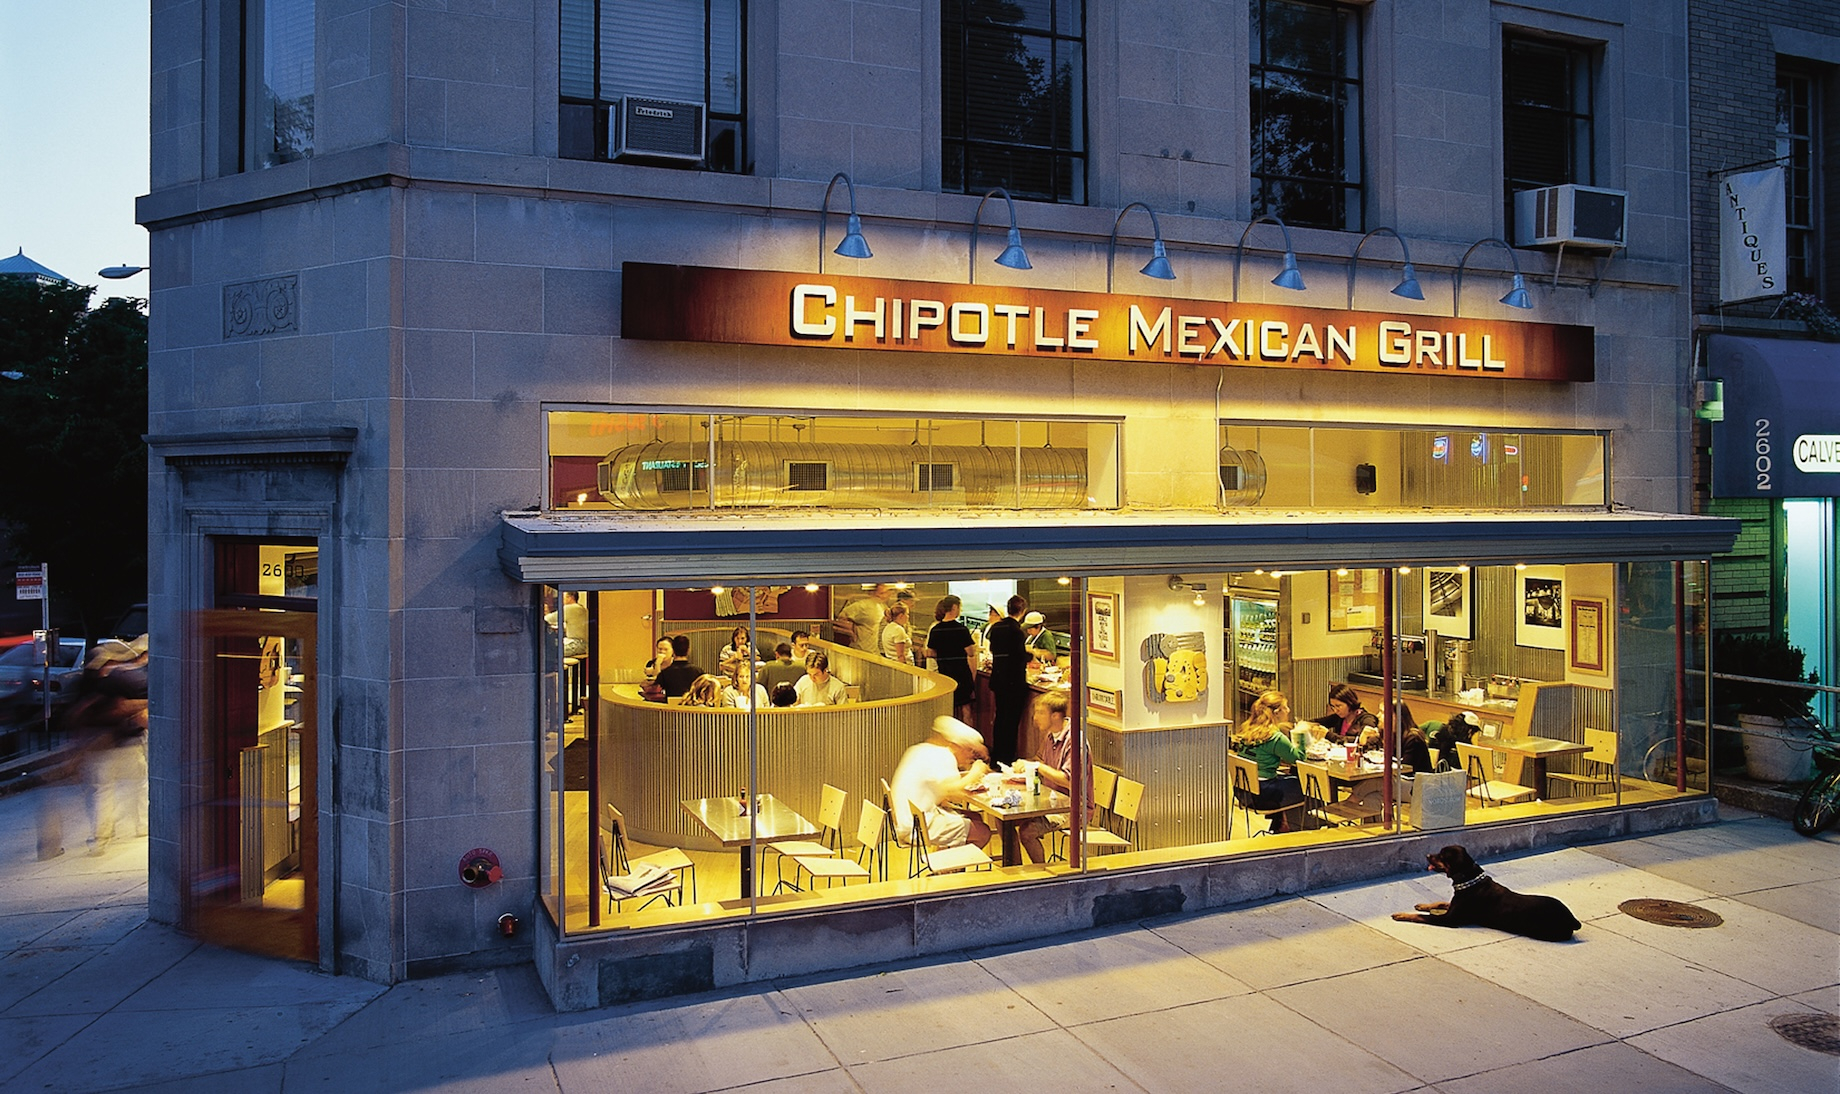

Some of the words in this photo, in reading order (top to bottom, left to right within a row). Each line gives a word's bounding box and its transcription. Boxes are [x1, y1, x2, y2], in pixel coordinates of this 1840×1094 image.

[1726, 183, 1774, 289] ANTIQUES
[792, 284, 1099, 349] CHIPOTLE
[1129, 304, 1357, 360] MEXICAN
[1378, 320, 1506, 368] GRILL
[1755, 419, 1772, 490] 2602
